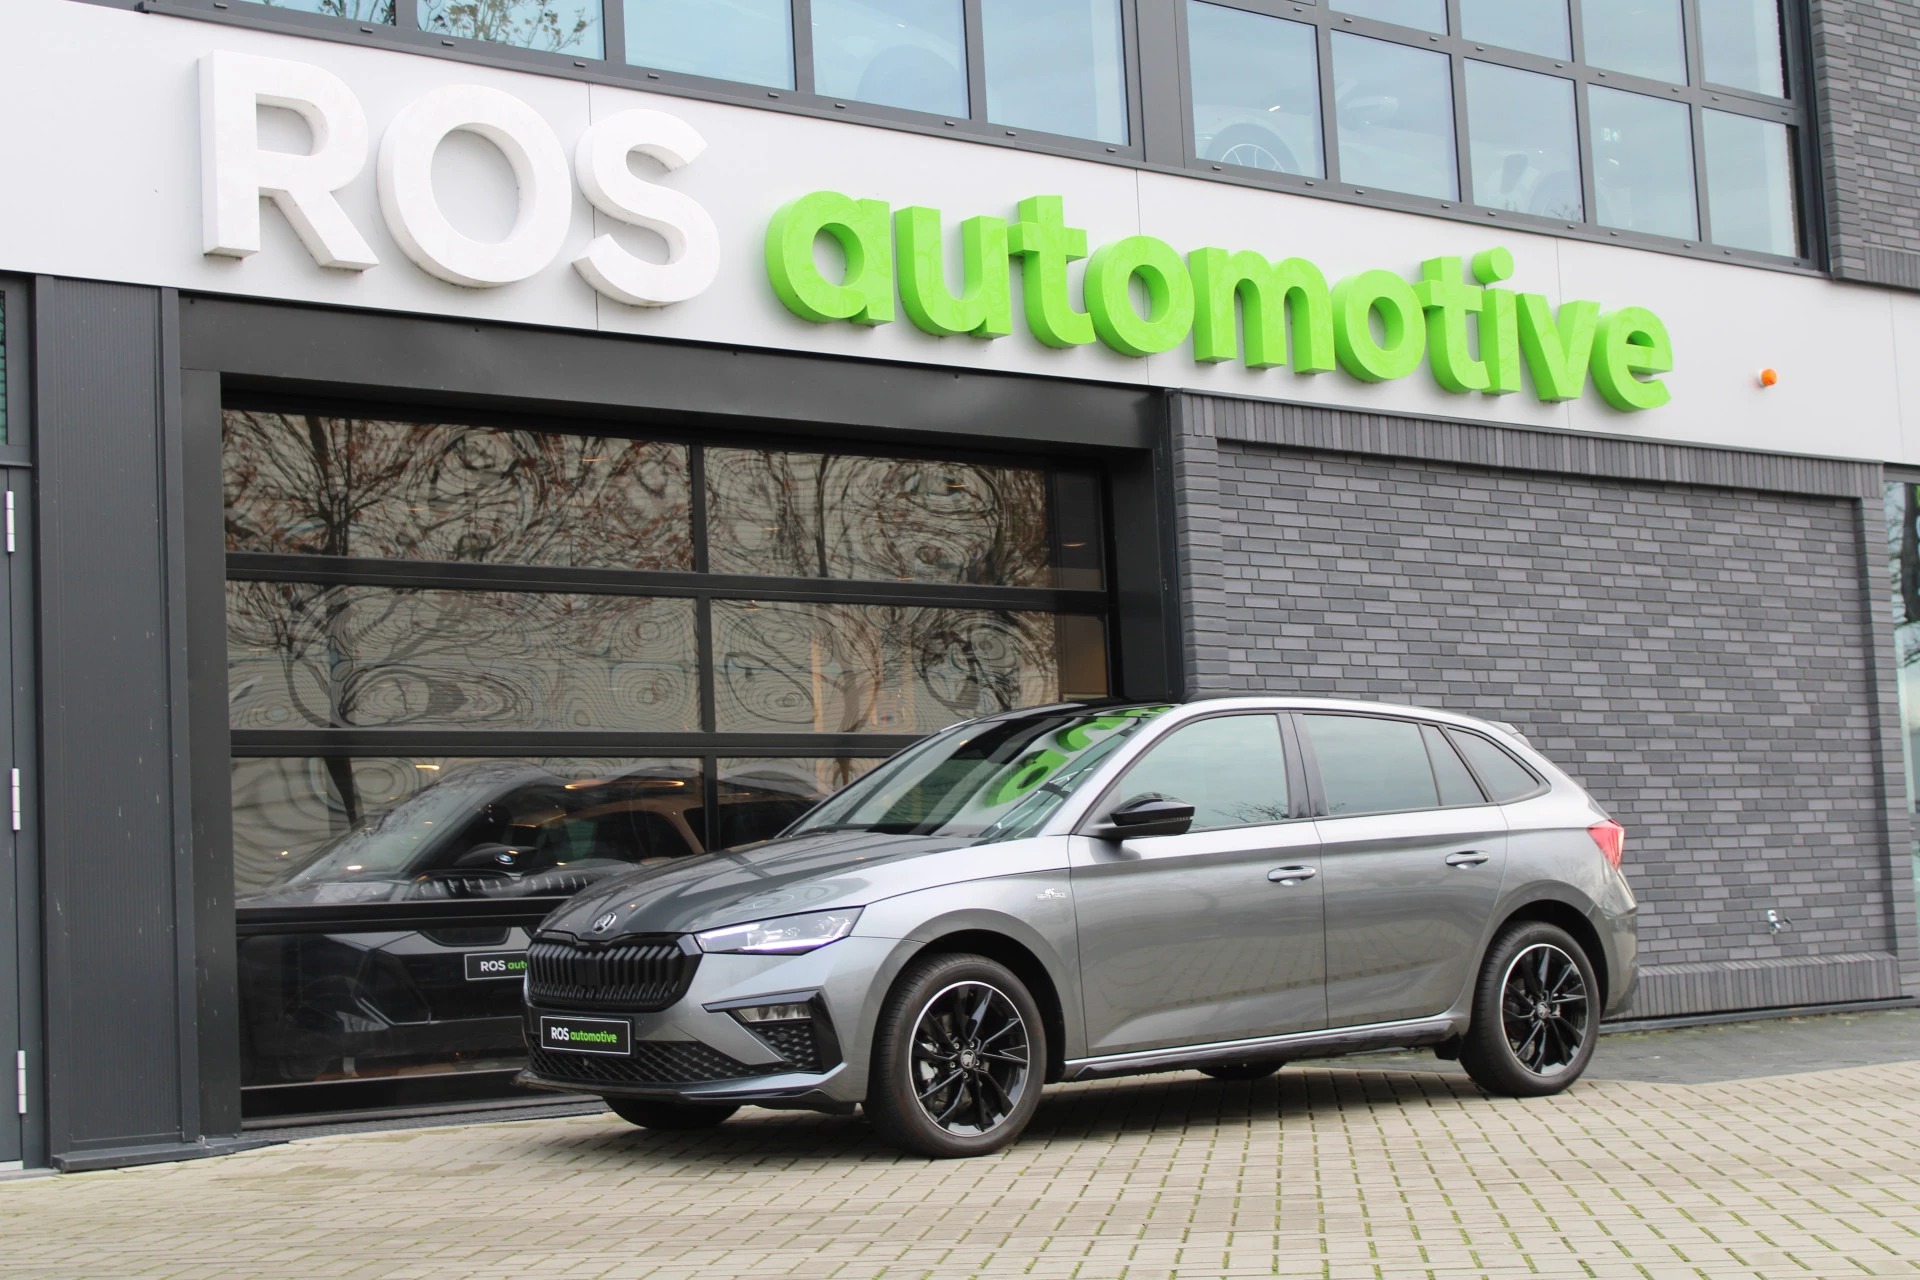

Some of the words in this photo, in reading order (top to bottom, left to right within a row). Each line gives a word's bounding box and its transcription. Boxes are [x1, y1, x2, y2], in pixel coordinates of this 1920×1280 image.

[199, 50, 720, 307] ROS
[764, 190, 1673, 413] automotive
[480, 960, 506, 971] ROS
[551, 1026, 569, 1041] ROS
[570, 1030, 618, 1043] automotive
